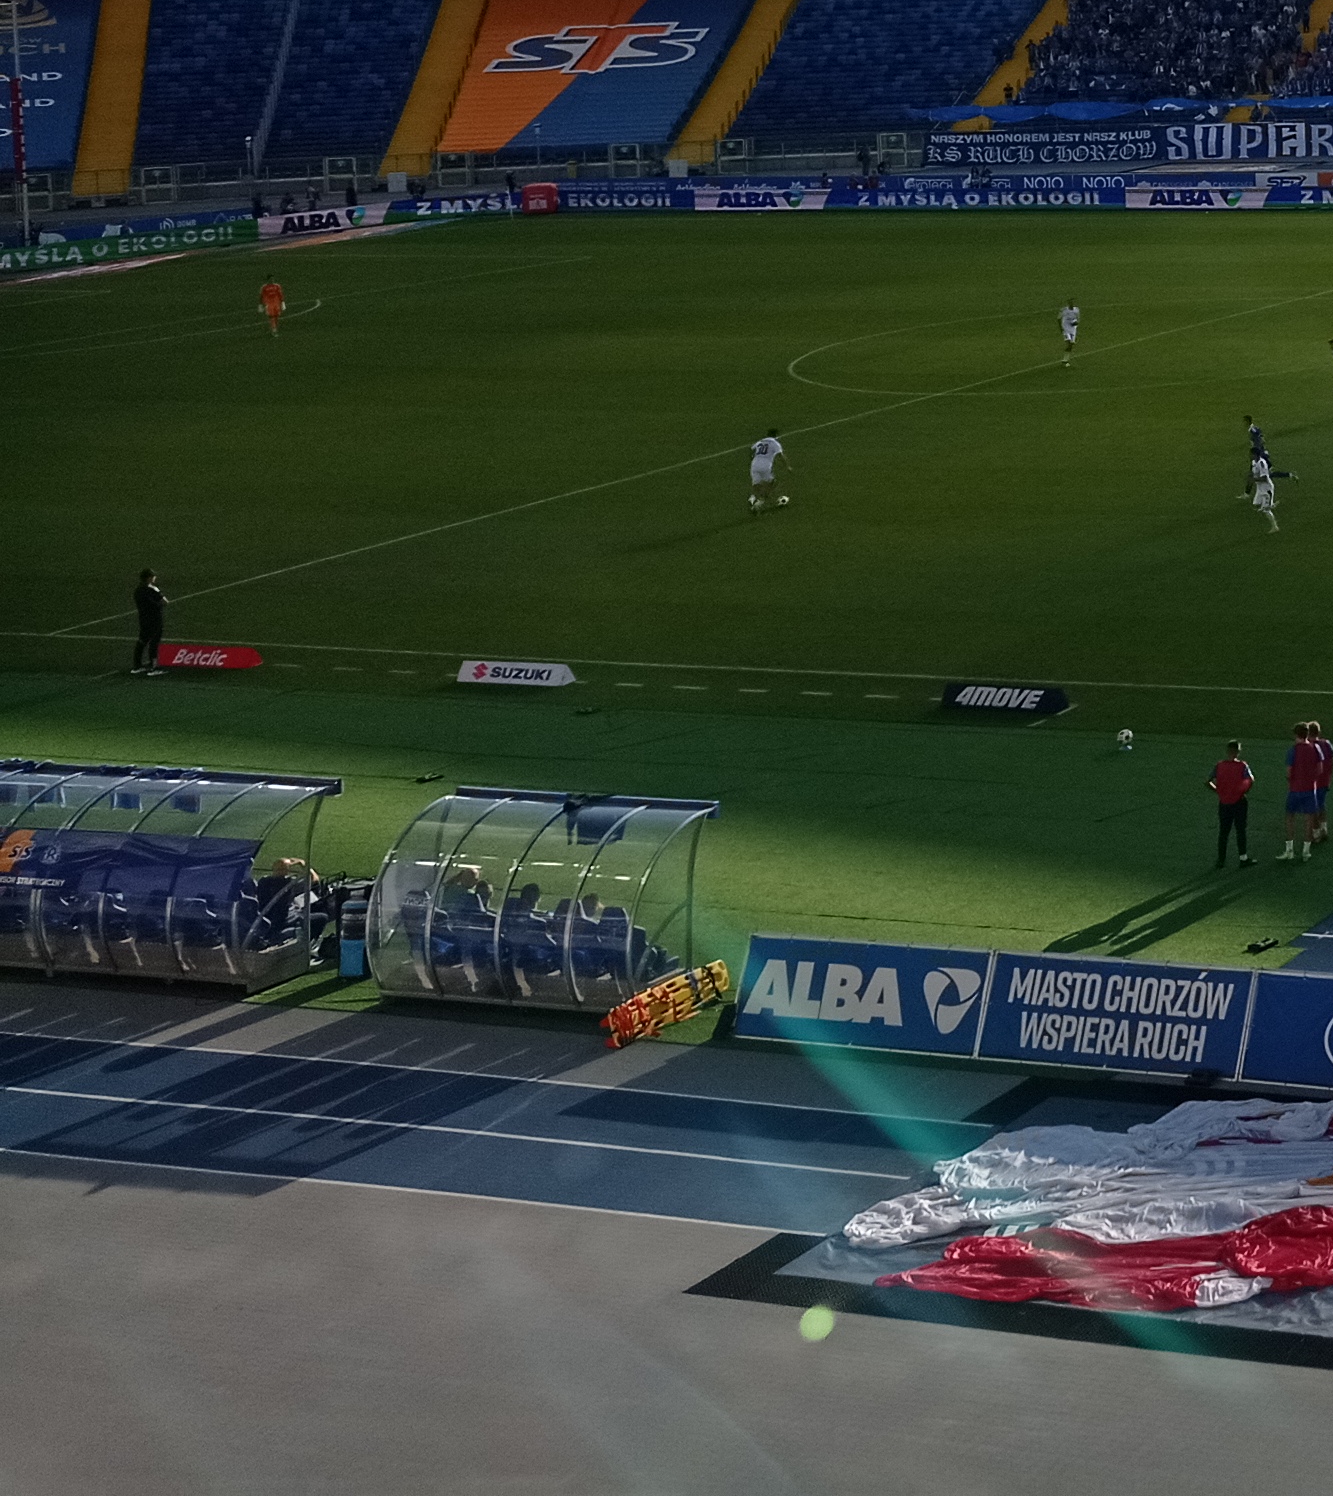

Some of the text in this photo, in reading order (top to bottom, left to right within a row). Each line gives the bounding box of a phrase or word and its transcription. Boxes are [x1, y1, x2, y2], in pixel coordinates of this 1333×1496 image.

[484, 22, 710, 74] STS
[931, 130, 1151, 144] NASZYM HONOREM JEST NASZ KLUB
[927, 145, 962, 163] KS
[968, 145, 1035, 165] RUCH
[416, 202, 431, 215] Z
[440, 194, 522, 214] MYŚL
[568, 193, 671, 207] EKOLOGII
[717, 192, 778, 208] ALBA
[858, 191, 1099, 209] Z MYŚLĄ O EKOLOGII
[1150, 190, 1214, 206] ALBA
[1301, 191, 1314, 203] Z
[280, 211, 341, 234] ALBA
[117, 226, 233, 252] EKOLOGII
[172, 648, 229, 667] Betclic
[490, 666, 552, 682] SUZUKI
[955, 686, 1045, 710] 4MOVE
[743, 959, 903, 1027] ALBA
[1008, 967, 1235, 1020] MIASTO CHORZÓW
[1019, 1011, 1207, 1062] WSPIERA RUCH
